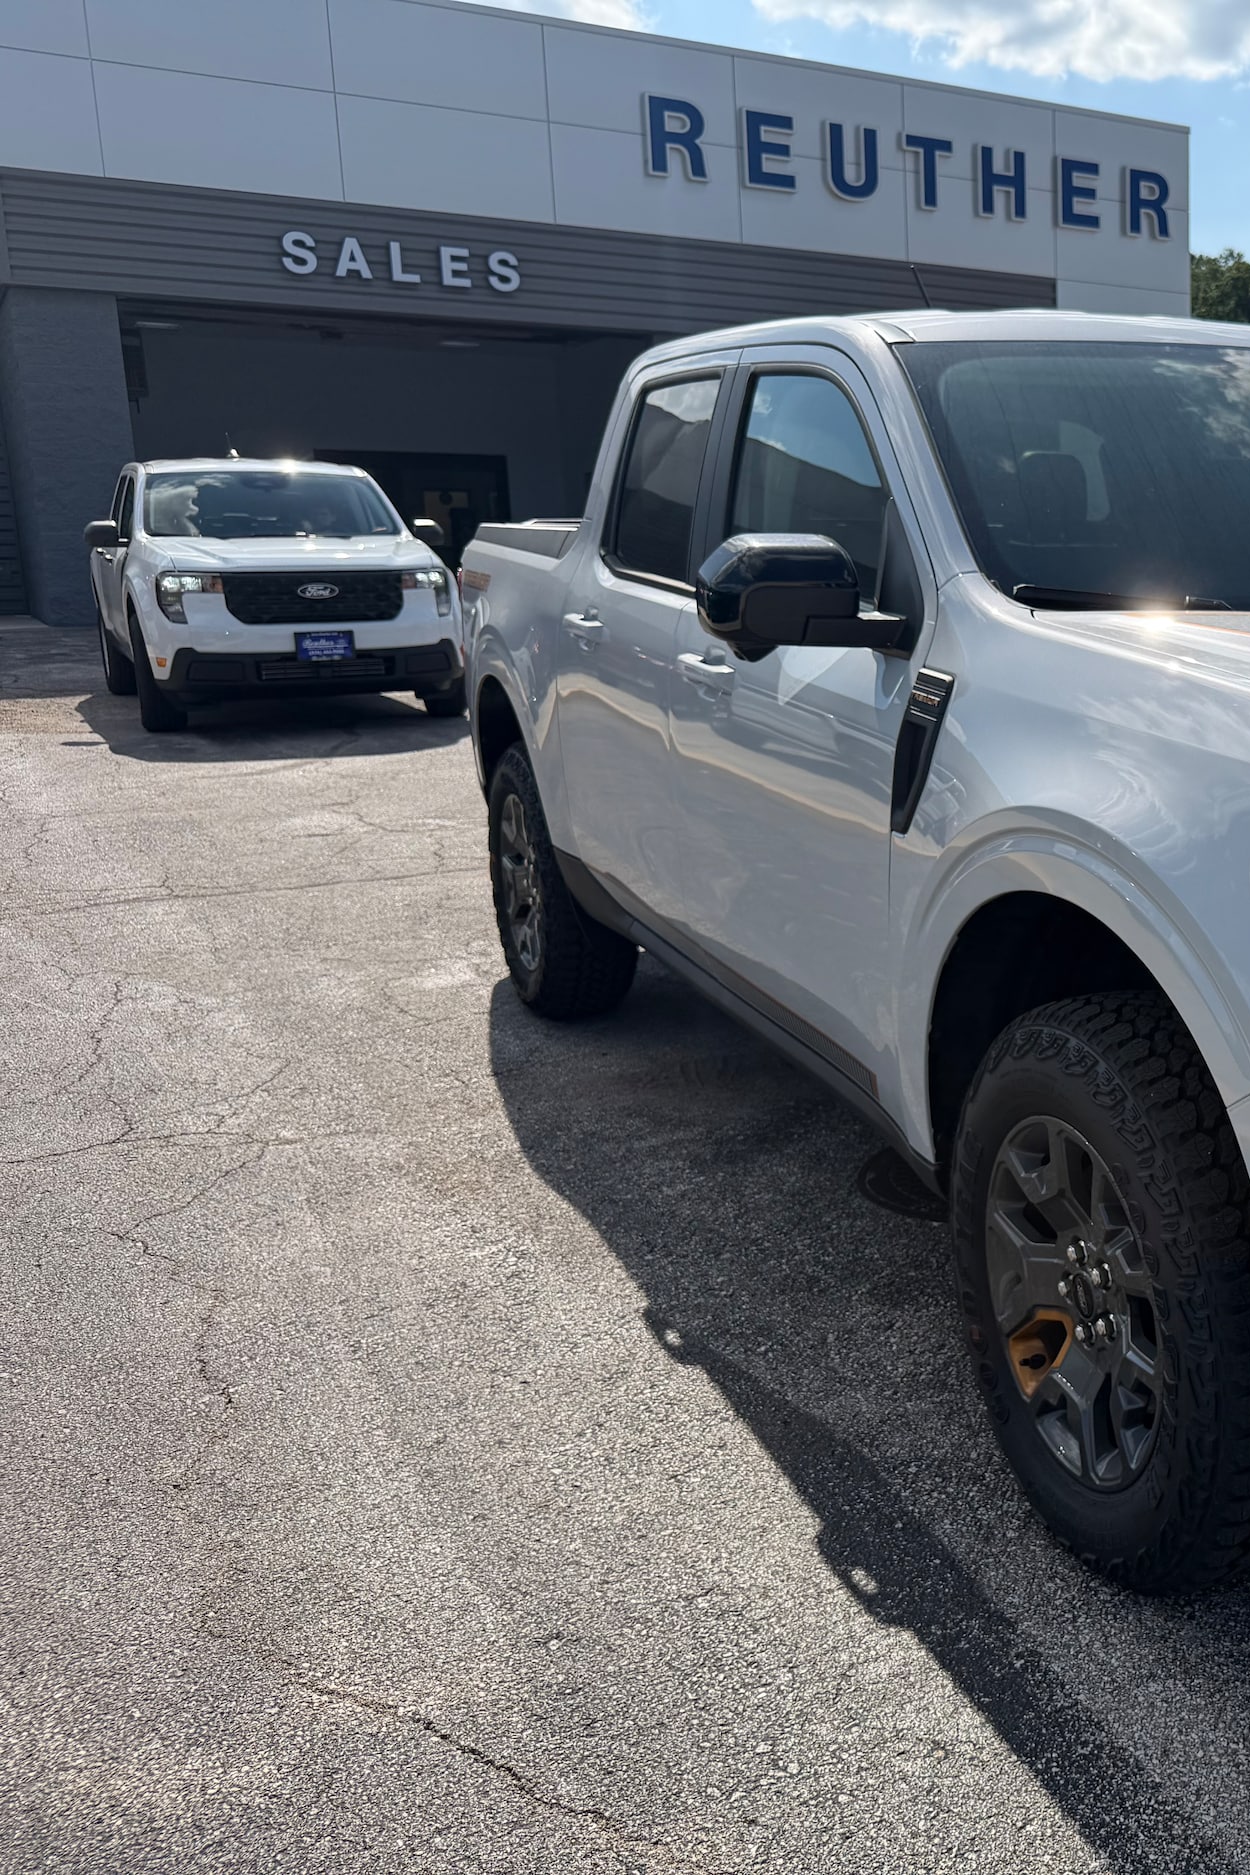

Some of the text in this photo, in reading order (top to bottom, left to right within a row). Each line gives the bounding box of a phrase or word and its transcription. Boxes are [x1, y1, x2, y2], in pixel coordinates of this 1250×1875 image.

[644, 93, 1172, 239] REUTHER
[282, 231, 521, 292] SALES
[305, 586, 331, 597] Ford
